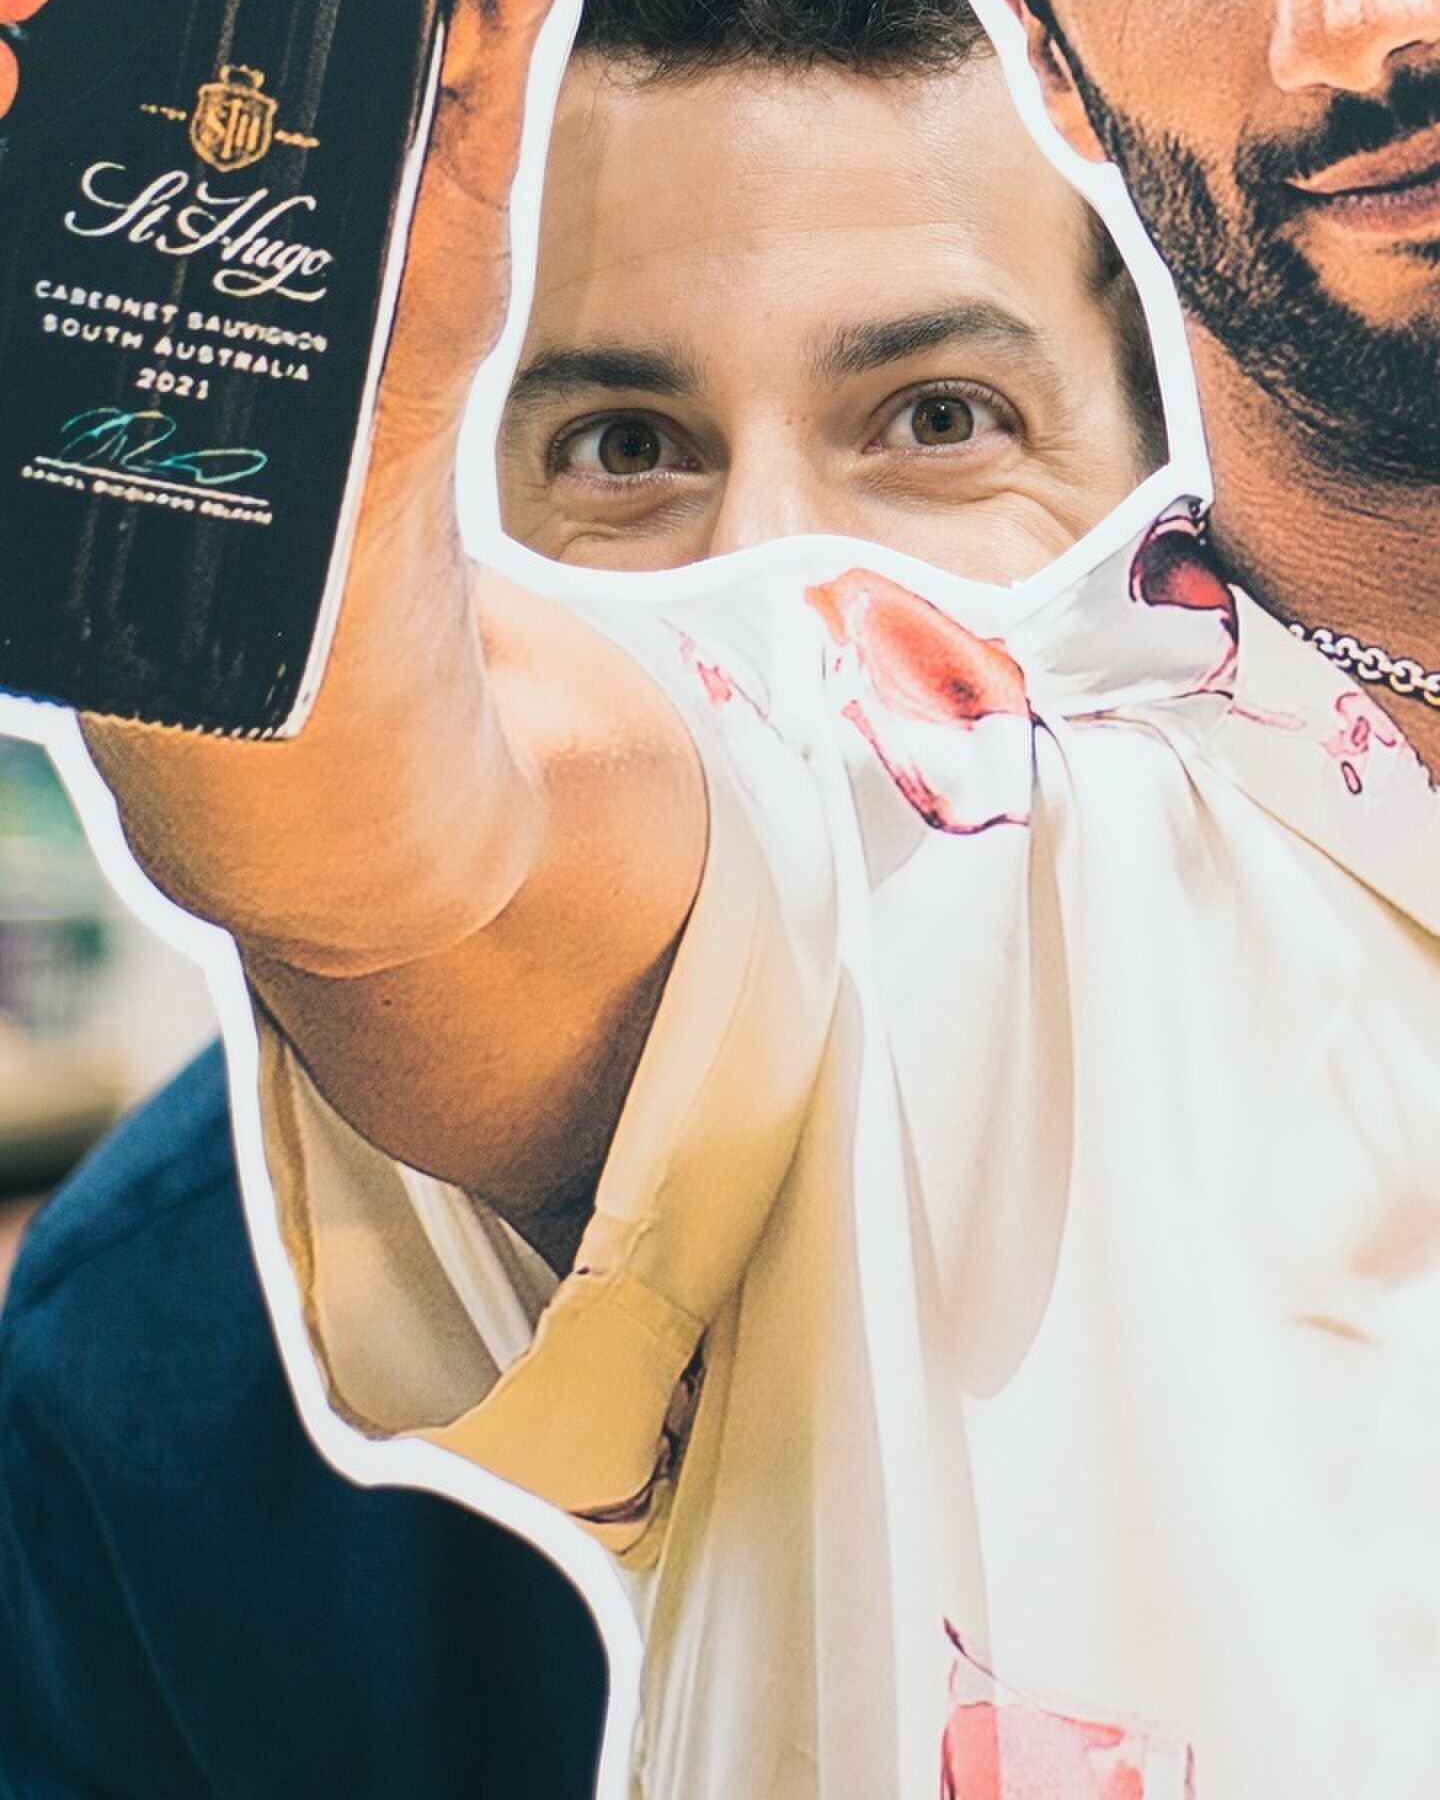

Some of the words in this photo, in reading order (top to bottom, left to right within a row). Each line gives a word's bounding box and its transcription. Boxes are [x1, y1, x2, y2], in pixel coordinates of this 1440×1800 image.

[34, 279, 179, 324] CABERNET
[186, 310, 328, 353] SAUVIGNON
[42, 312, 144, 350] SOUTH
[153, 335, 310, 382] AUSTRALIA
